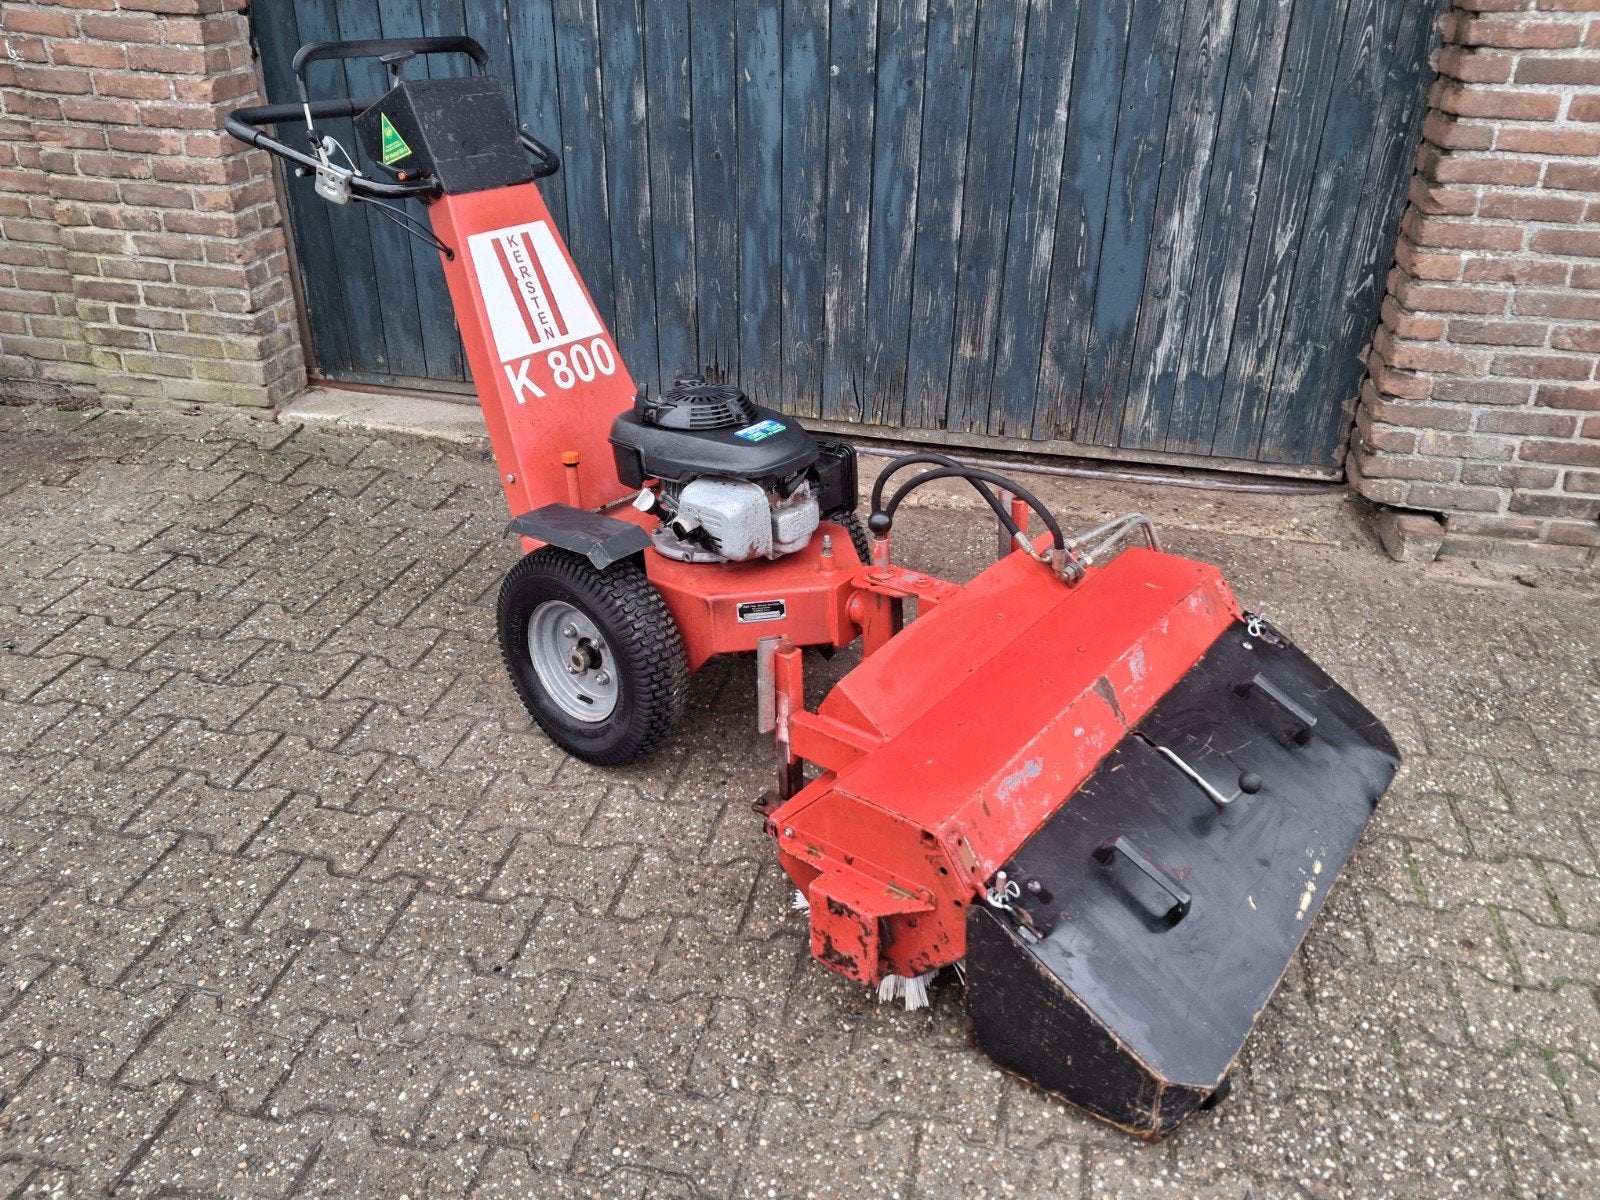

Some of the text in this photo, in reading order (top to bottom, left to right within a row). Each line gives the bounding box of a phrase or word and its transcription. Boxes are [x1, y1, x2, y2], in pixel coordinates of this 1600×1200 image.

[507, 235, 555, 340] KERSTEN
[503, 337, 616, 404] K 800
